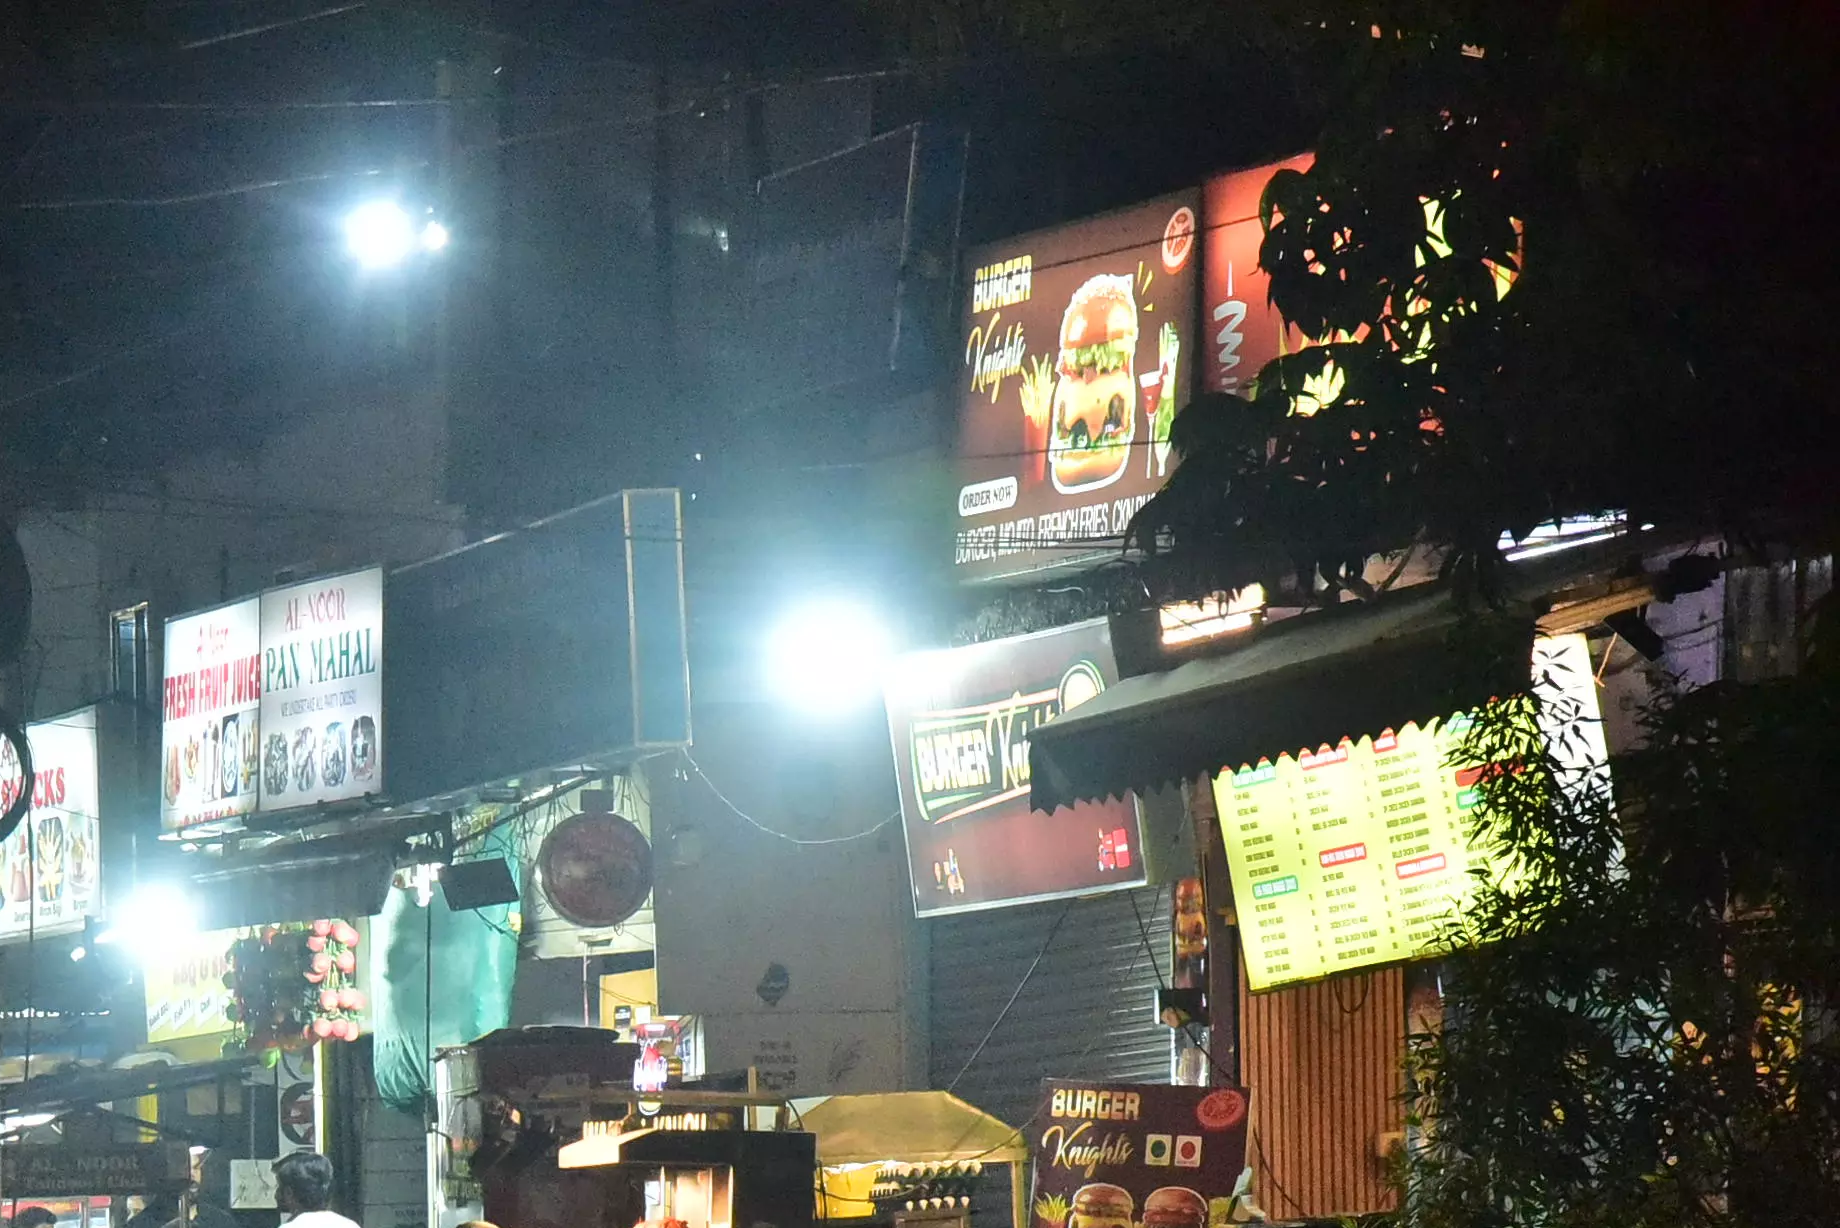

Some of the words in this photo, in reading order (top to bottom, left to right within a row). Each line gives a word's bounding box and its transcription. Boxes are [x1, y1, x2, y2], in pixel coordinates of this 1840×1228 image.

[972, 254, 1032, 314] BURGER
[965, 311, 1026, 404] Knights
[962, 488, 991, 510] ORDER
[992, 485, 1013, 504] NOW
[163, 671, 196, 722] FRESH
[198, 663, 229, 713] FRUIT
[231, 653, 260, 706] JUICE
[264, 642, 301, 693] PAN
[309, 627, 376, 685] MAHAL
[915, 728, 991, 792] BURGER
[1, 767, 66, 815] SNCKS
[1050, 1088, 1141, 1120] BURGER
[1041, 1120, 1134, 1178] Knights
